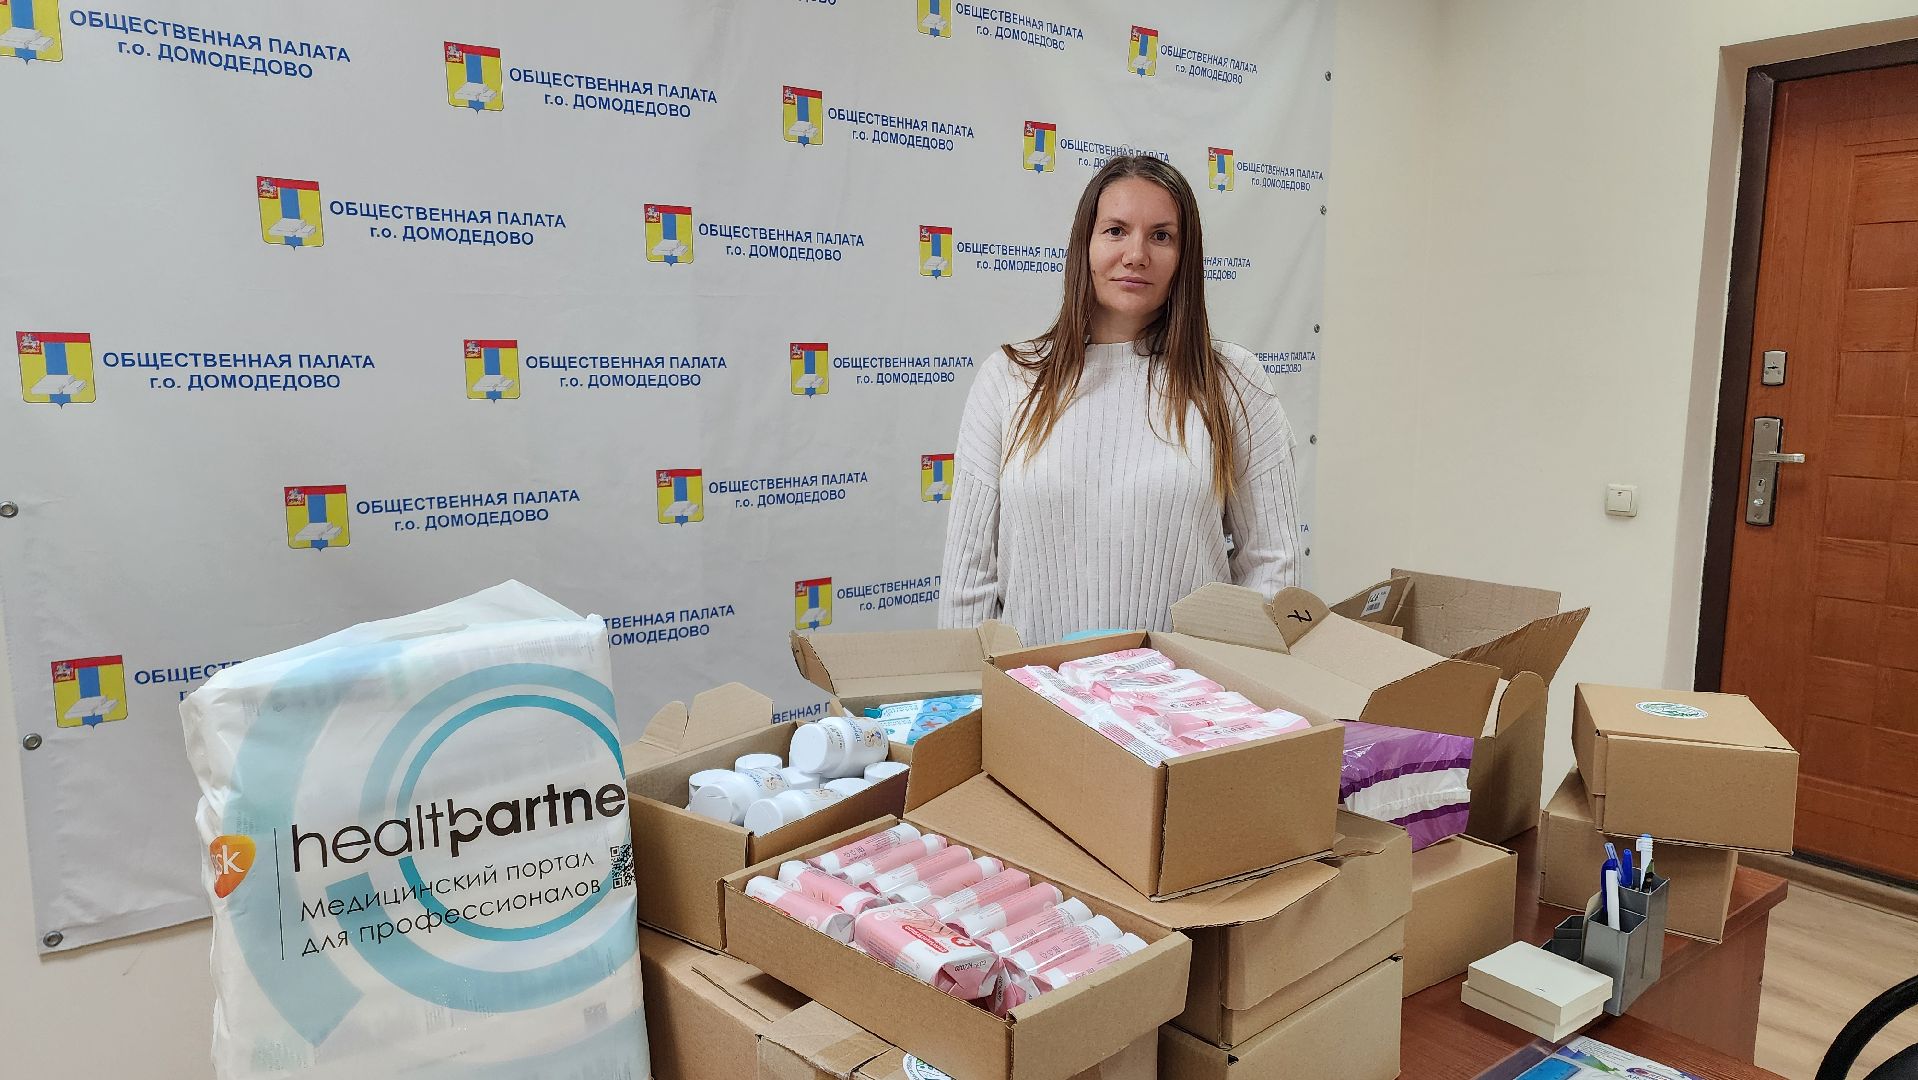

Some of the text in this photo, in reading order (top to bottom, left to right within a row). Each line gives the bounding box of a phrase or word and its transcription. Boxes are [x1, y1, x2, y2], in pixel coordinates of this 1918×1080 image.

[956, 3, 1083, 40] ОБЩЕСТВЕННАЯ ПАЛАТА
[70, 10, 350, 62] ОБЩЕСТВЕННАЯ ПАЛАТА
[118, 42, 312, 78] г.о. ДОМОДЕДОВО
[510, 68, 717, 103] ОБЩЕСТВЕННАЯ ПАЛАТА
[545, 93, 690, 117] г.о. ДОМОДЕДОВО
[828, 108, 974, 138] ОБЩЕСТВЕННАЯ ПАЛАТА
[872, 130, 953, 151] ДОМОДЕДОВО
[330, 201, 566, 228] ОБЩЕСТВЕННАЯ ПАЛАТА
[370, 226, 533, 246] г.о. ДОМОДЕДОВО
[699, 223, 864, 246] ОБЩЕСТВЕННАЯ ПАЛАТА
[726, 244, 841, 262] г.о. ДОМОДЕДОВО
[957, 242, 1040, 257] ОБЩЕСТВЕННАЯ
[994, 259, 1063, 273] ДОМОДЕДОВО
[1203, 269, 1237, 281] ОДЕДОВО
[103, 352, 375, 370] ОБЩЕСТВЕННАЯ ПАЛАТА
[526, 356, 727, 371] ОБЩЕСТВЕННАЯ ПАЛАТА
[833, 356, 974, 370] ОБЩЕСТВЕННАЯ ПАЛАТА
[150, 374, 340, 391] г.о. ДОМОДЕДОВО
[560, 374, 701, 389] г.о. ДОМОДЕДОВО
[876, 372, 954, 385] ДОМОДЕДОВО
[709, 472, 868, 493] ОБЩЕСТВЕННАЯ ПАЛАТА
[356, 490, 580, 514] ОБЩЕСТВЕННАЯ ПАЛАТА
[736, 489, 845, 508] г.о. ДОМОДЕДОВО
[395, 509, 548, 531] г.о. ДОМОДЕДОВО
[837, 577, 930, 599] ОБЩЕСТВЕННАЯ
[878, 590, 939, 610] ДОМОДЕДО
[603, 605, 735, 630] ТВЕННАЯ ПАЛАТА
[609, 624, 709, 650] ОМОДЕДОВО
[291, 783, 626, 873] healthpartne
[301, 852, 595, 922] Медицинский портал
[302, 879, 601, 957] для профессионалов
